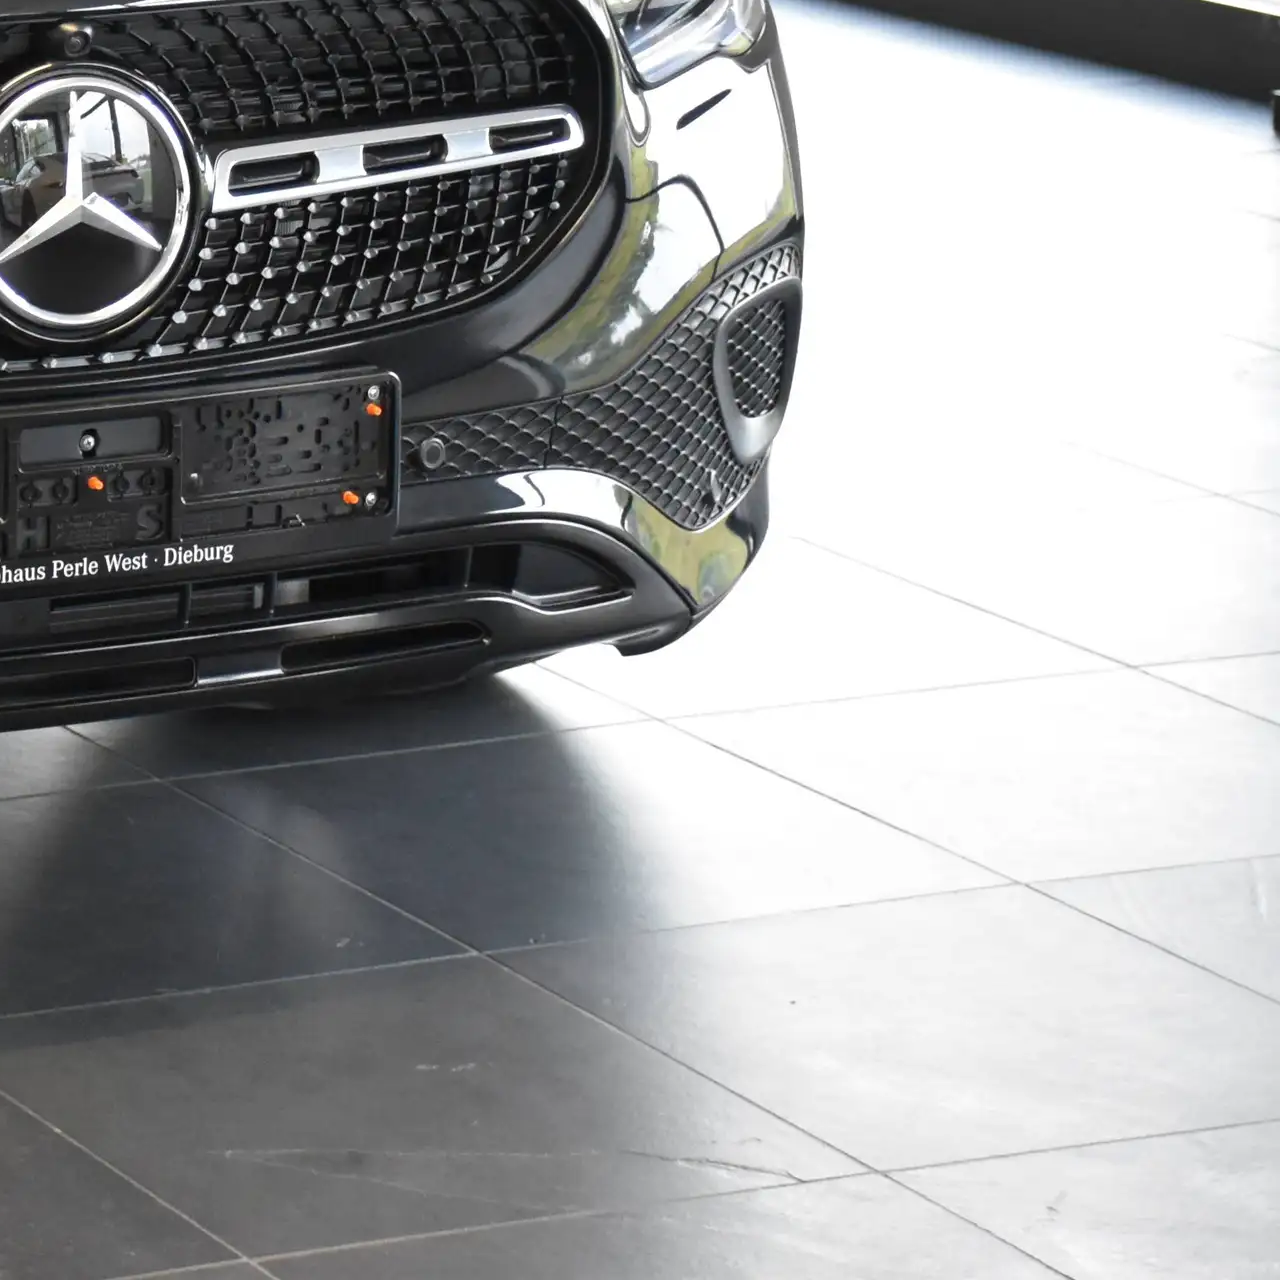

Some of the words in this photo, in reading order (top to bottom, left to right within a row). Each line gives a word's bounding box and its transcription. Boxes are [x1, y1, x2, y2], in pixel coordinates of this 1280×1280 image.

[51, 558, 99, 579] Perle
[104, 552, 148, 573] West
[163, 544, 234, 567] Dieburg
